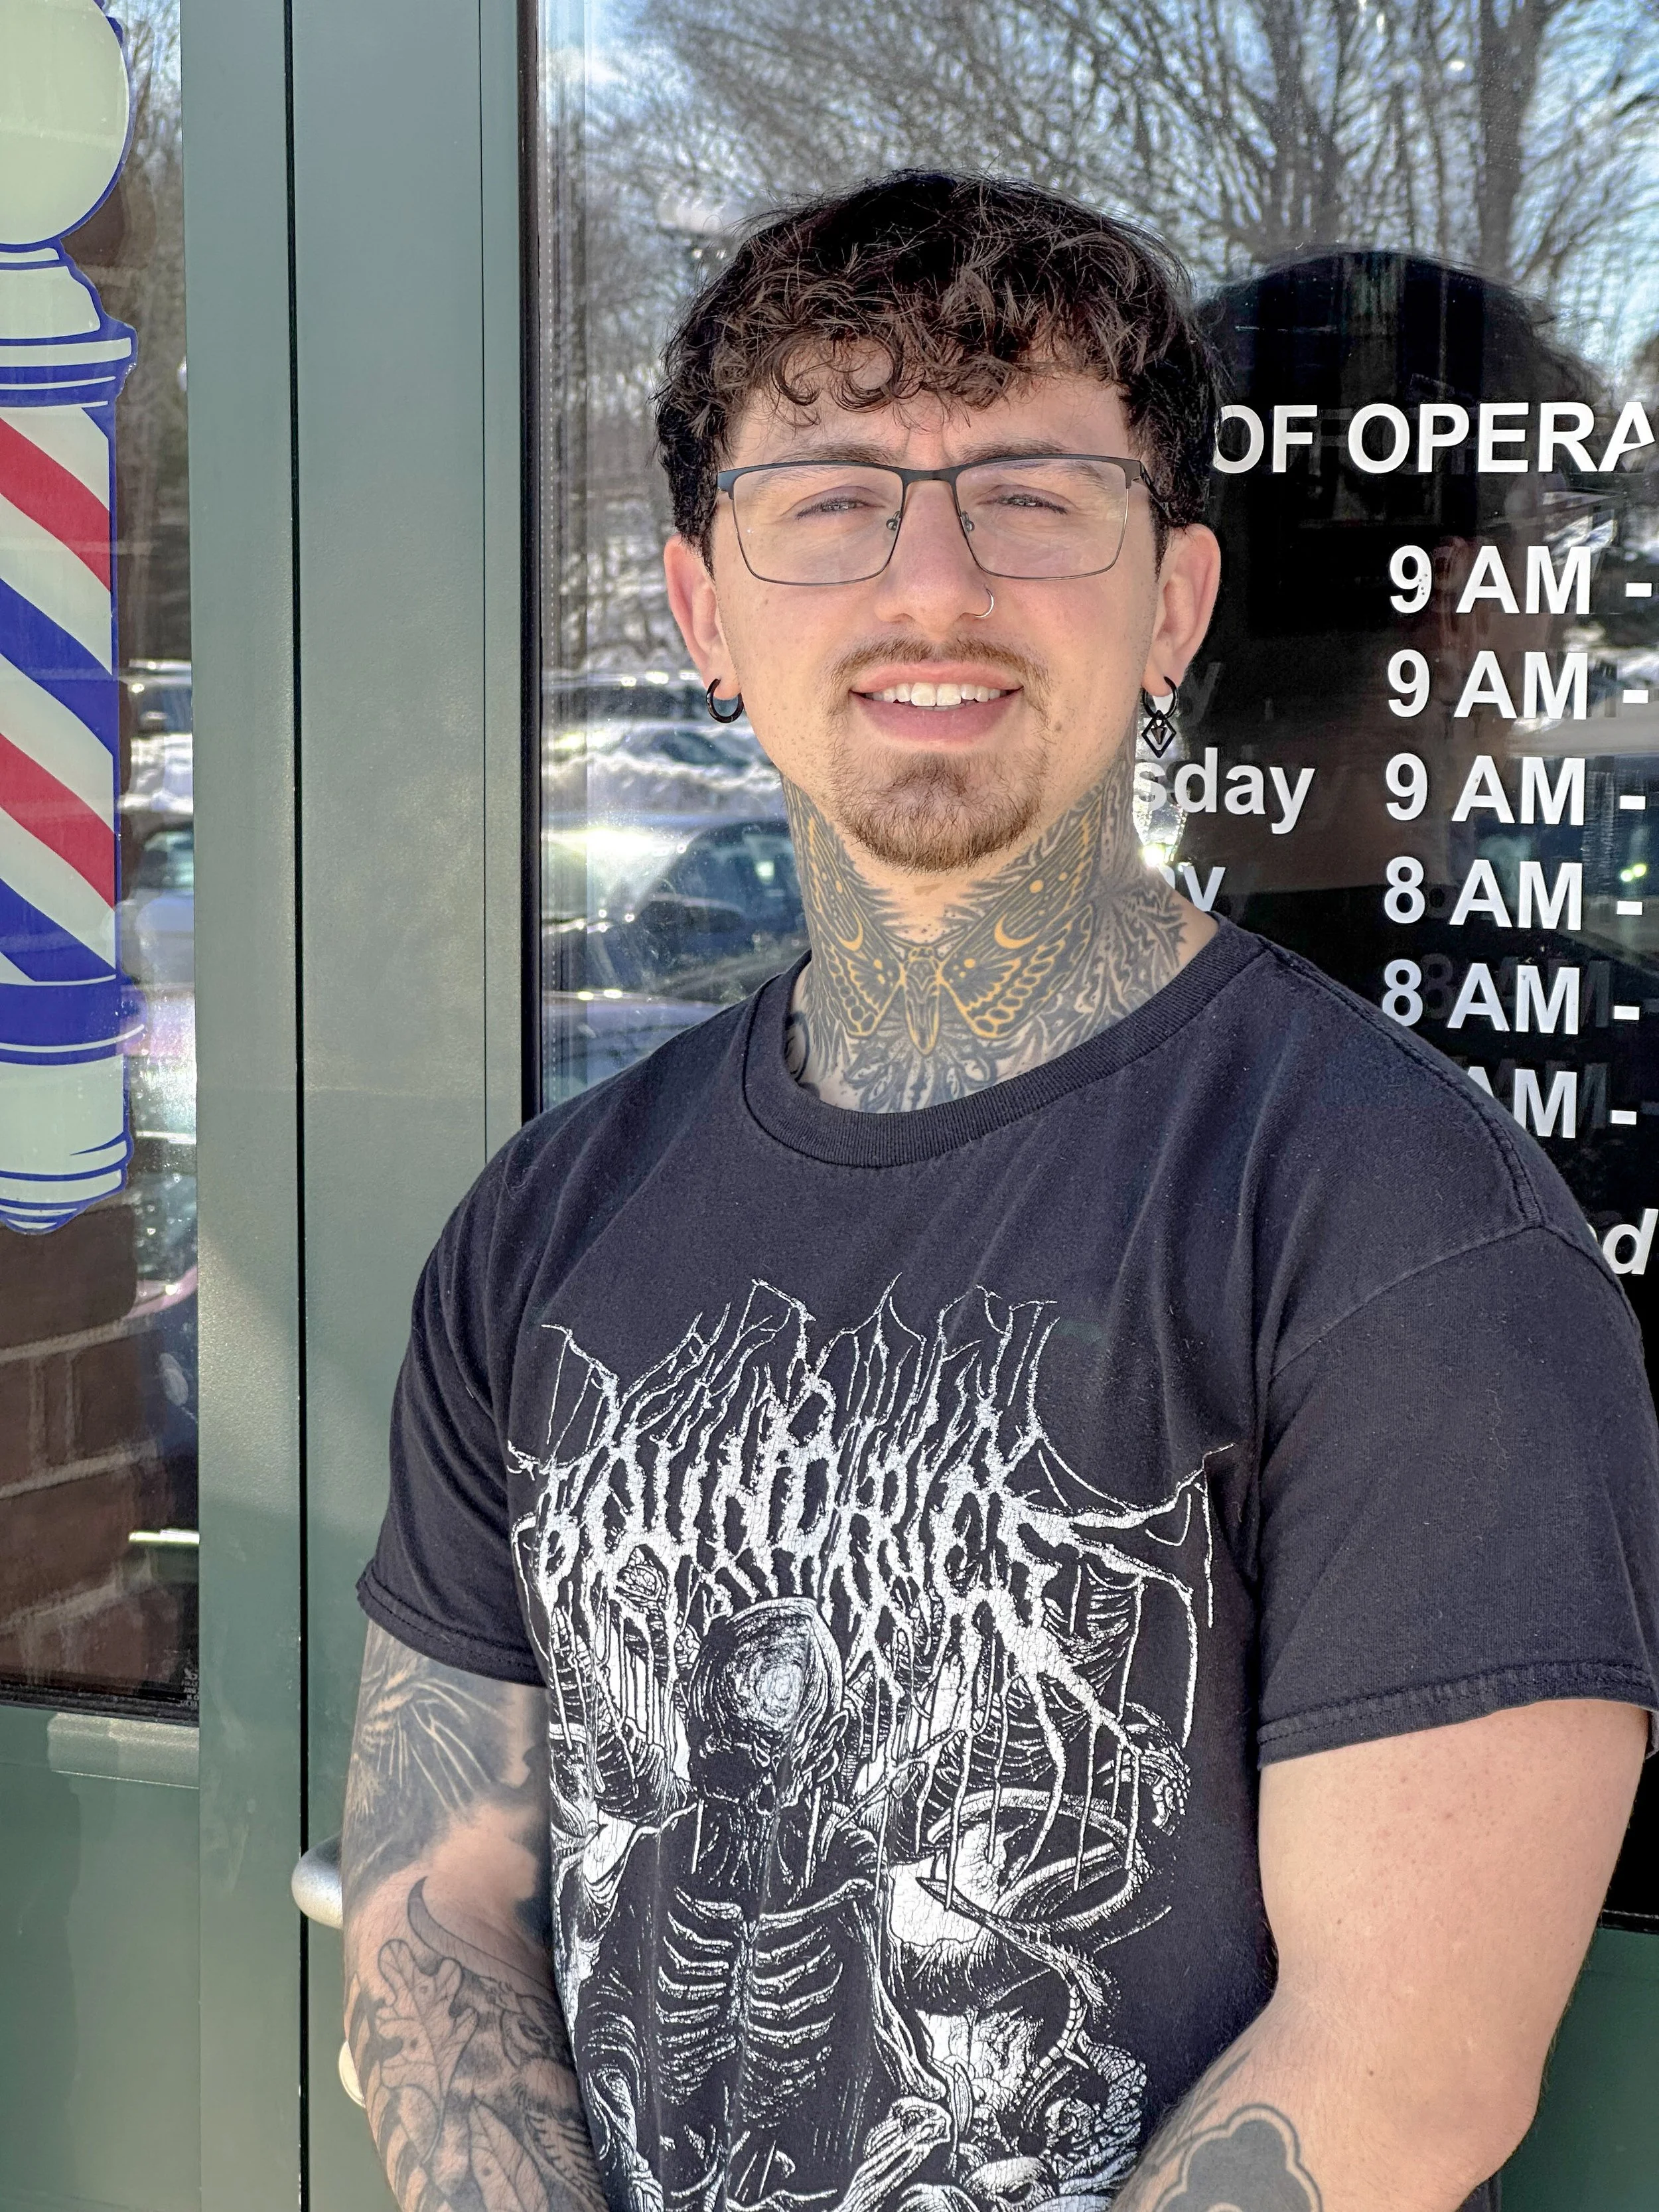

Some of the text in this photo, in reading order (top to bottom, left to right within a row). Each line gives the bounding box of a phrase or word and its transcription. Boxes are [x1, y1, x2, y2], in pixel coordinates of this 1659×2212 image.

[1214, 404, 1318, 474] OF
[1390, 545, 1432, 614] 9
[1456, 546, 1591, 615] AM
[1388, 649, 1430, 717] 9
[1454, 650, 1588, 720] AM
[1386, 753, 1427, 821] 9
[1451, 755, 1585, 826] AM
[1384, 856, 1425, 924] 8
[1449, 859, 1583, 931] AM
[1382, 959, 1423, 1027] 8
[1447, 962, 1580, 1035] AM
